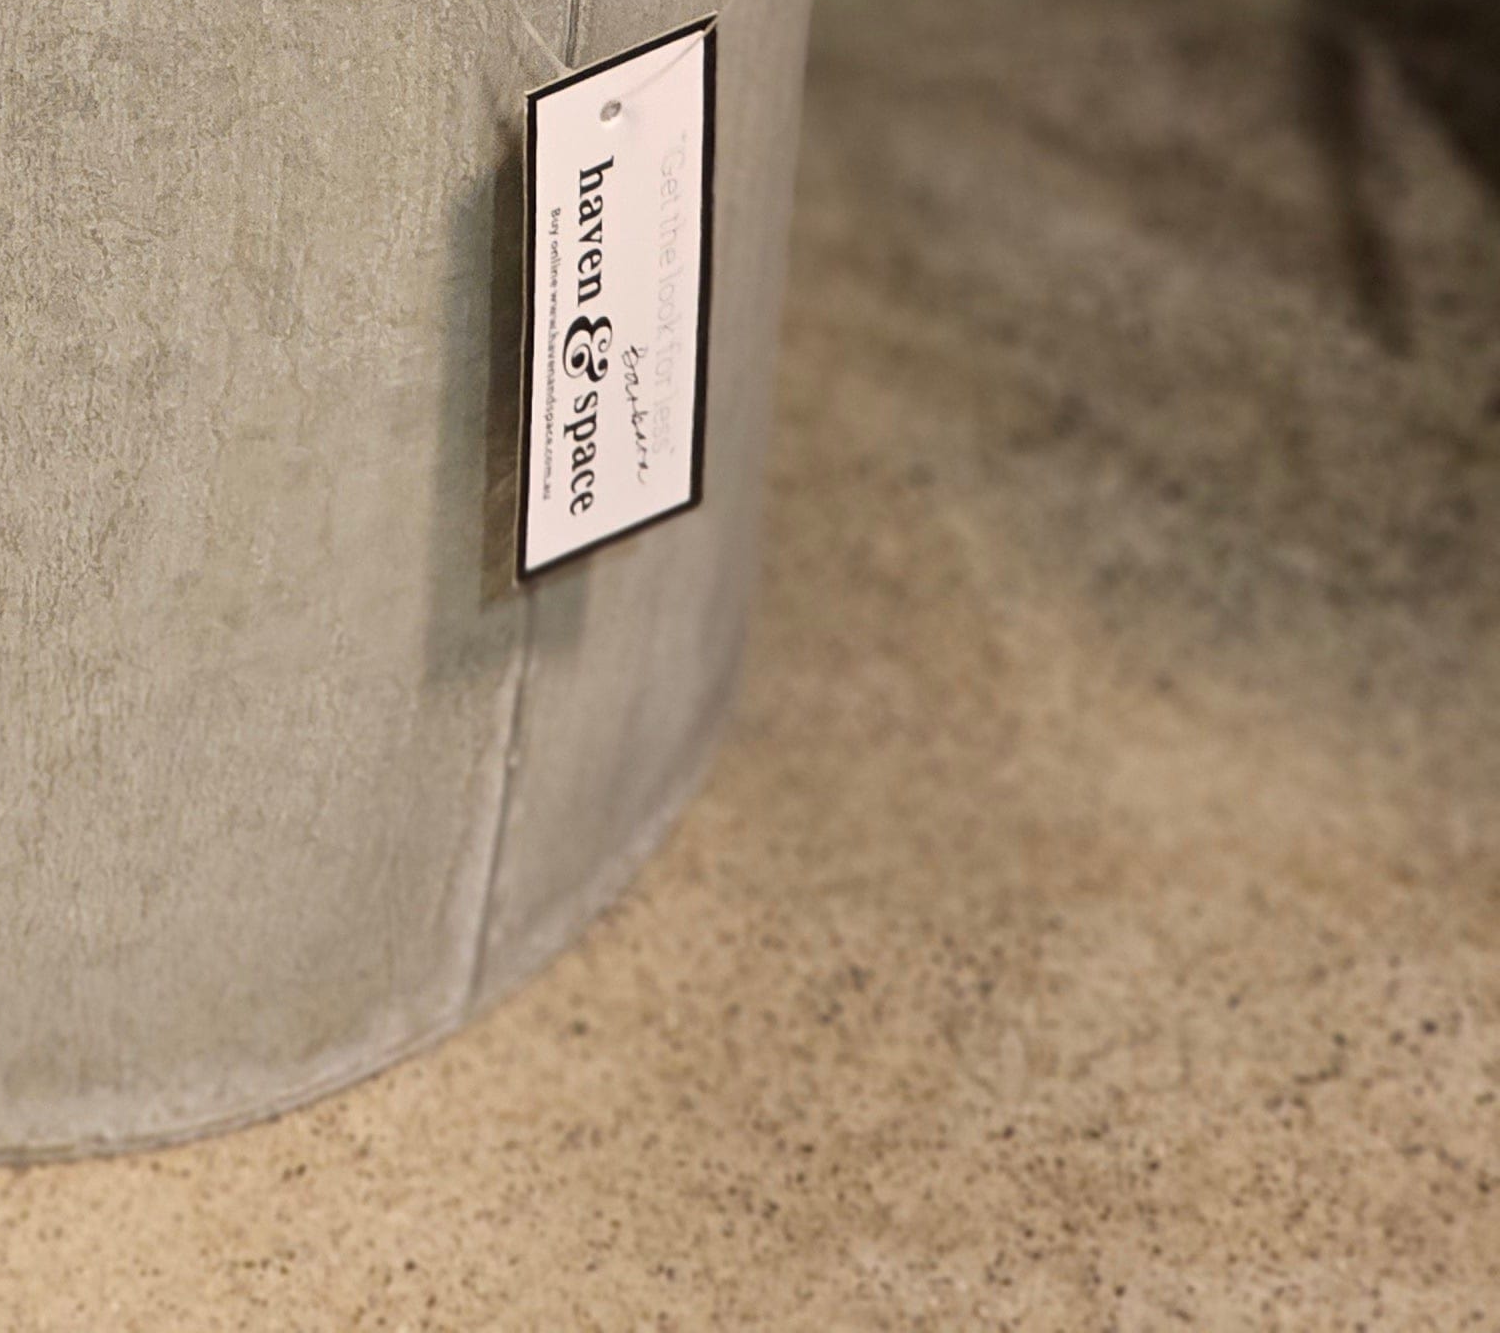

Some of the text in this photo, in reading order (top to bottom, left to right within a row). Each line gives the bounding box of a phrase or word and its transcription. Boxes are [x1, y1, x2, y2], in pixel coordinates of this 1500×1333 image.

[549, 207, 561, 236] Buy
[549, 240, 562, 289] online
[657, 265, 685, 339] look
[563, 155, 615, 516] haven & space
